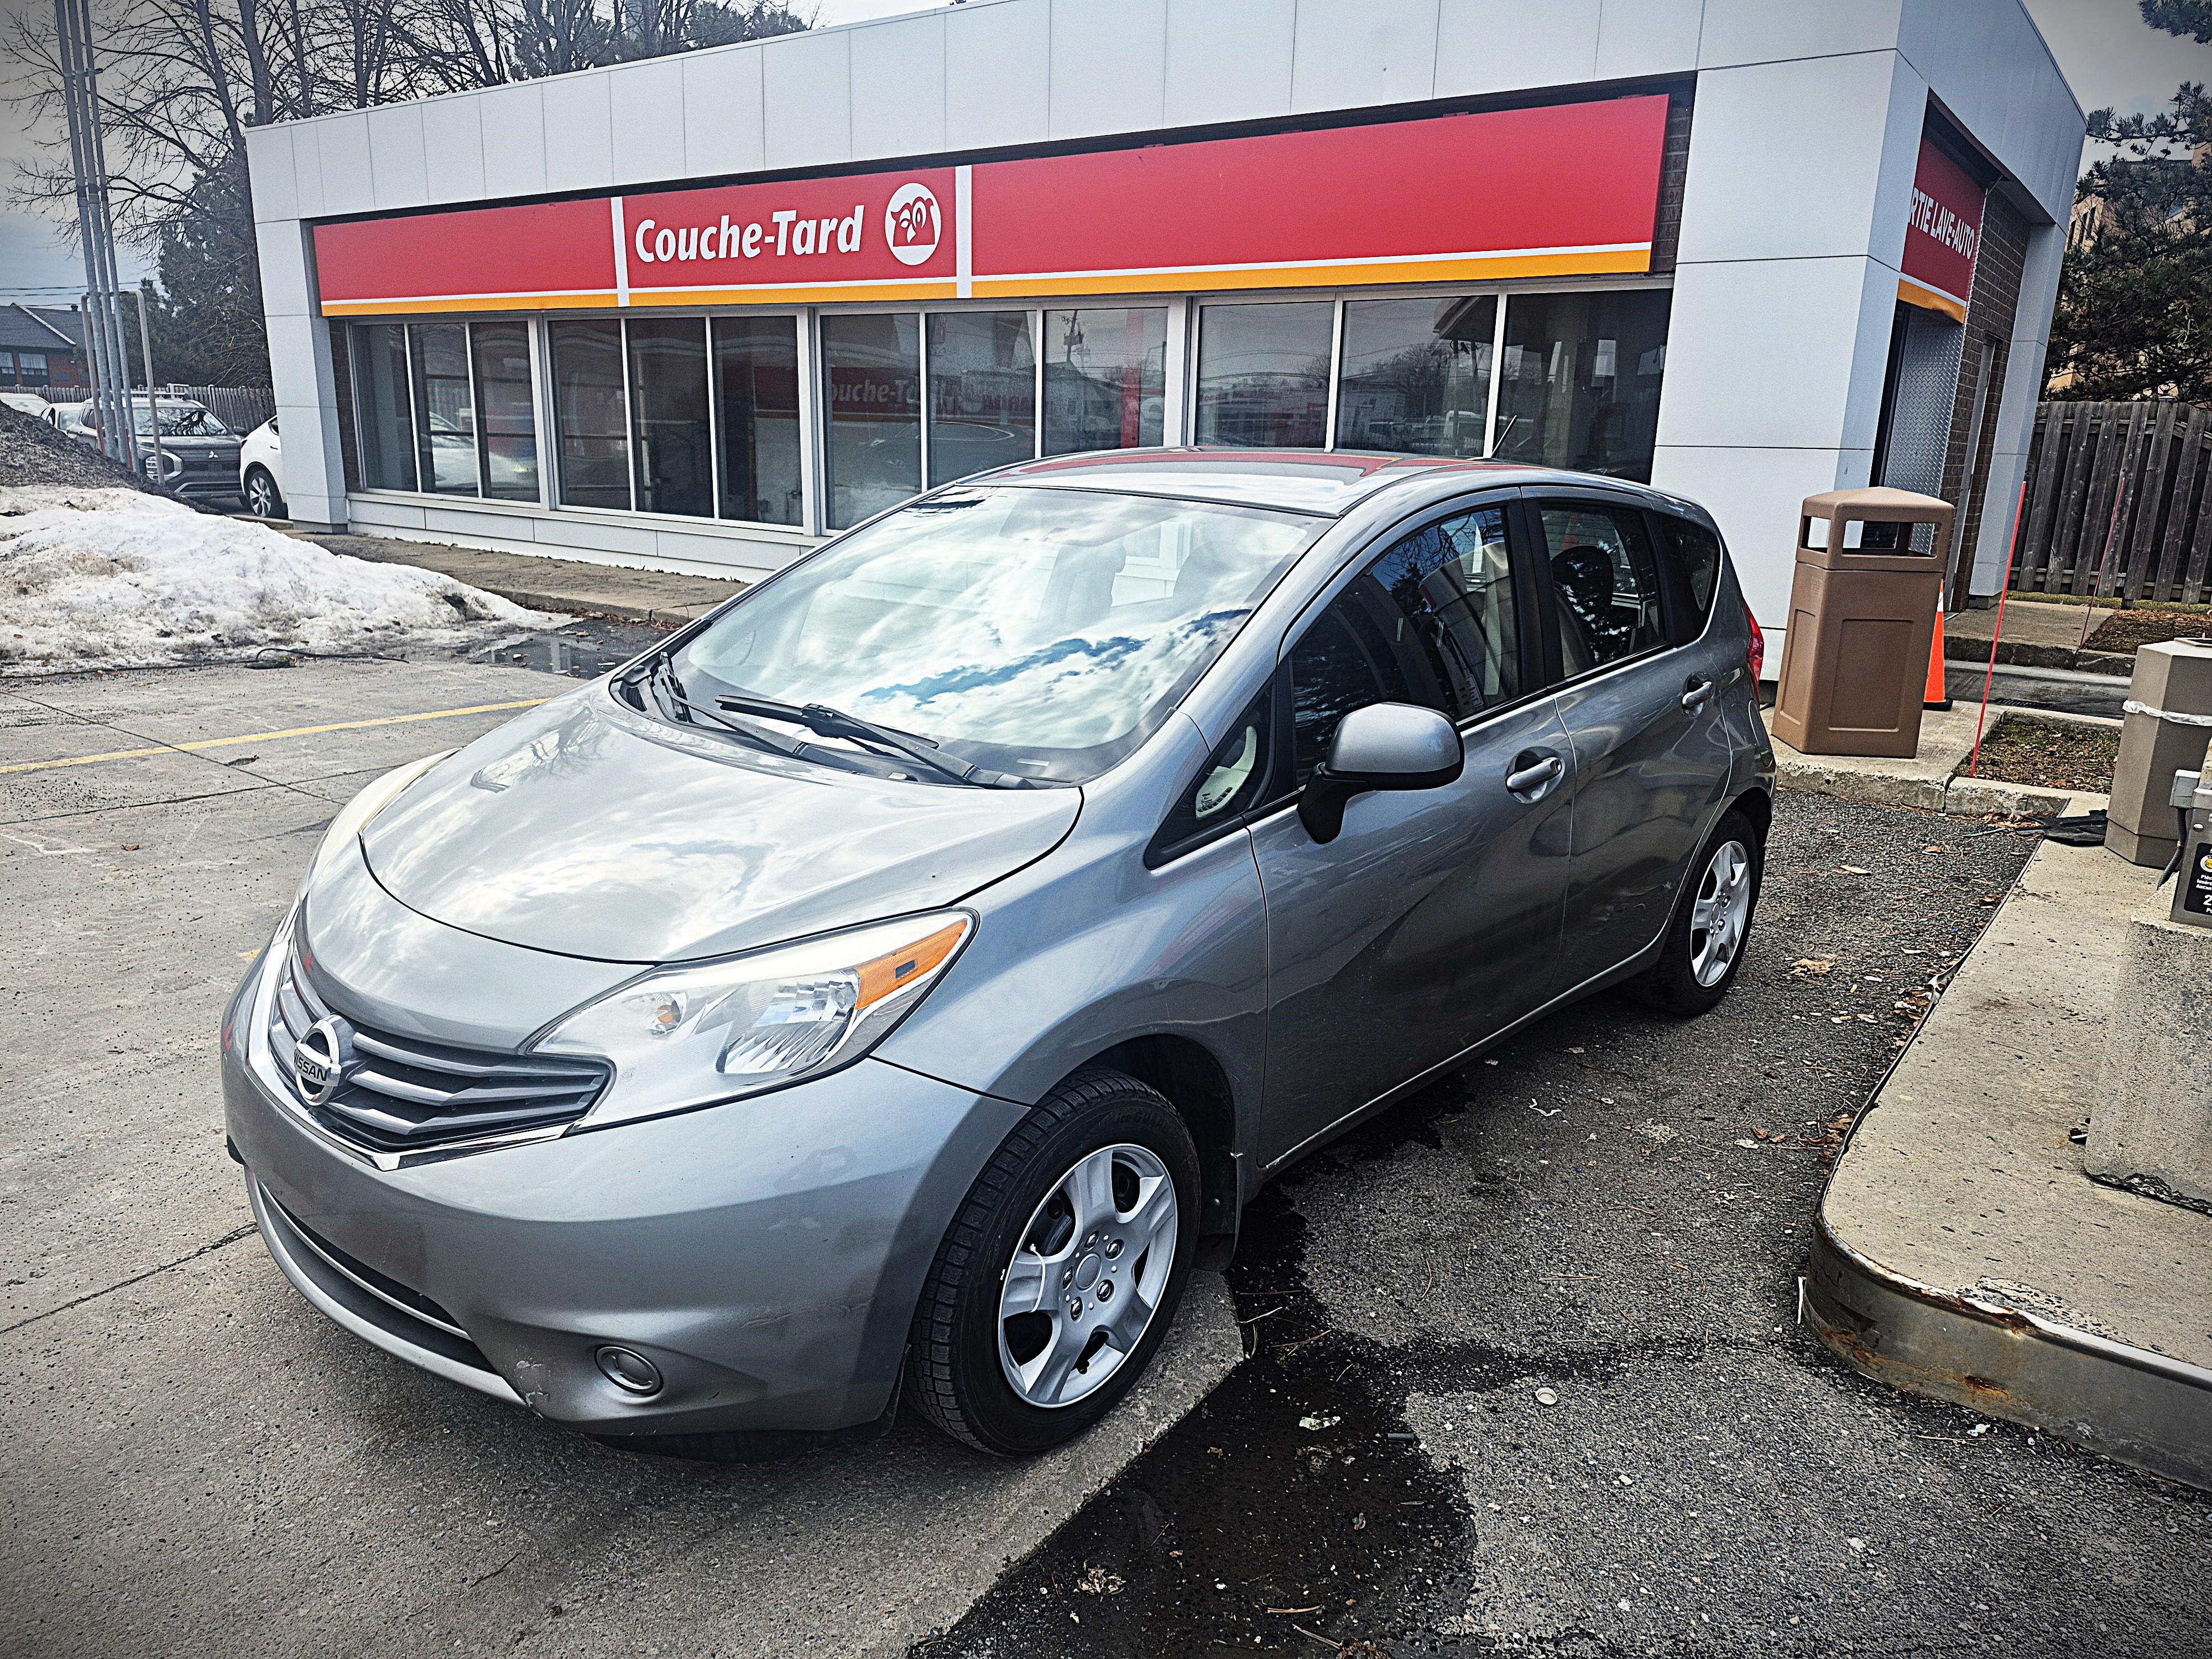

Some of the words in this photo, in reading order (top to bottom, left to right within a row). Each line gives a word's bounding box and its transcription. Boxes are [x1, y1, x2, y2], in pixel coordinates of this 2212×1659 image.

[635, 205, 864, 263] Couche-Tard
[1930, 202, 1975, 260] LAVE-AUTO
[294, 1050, 328, 1081] NISSAN
